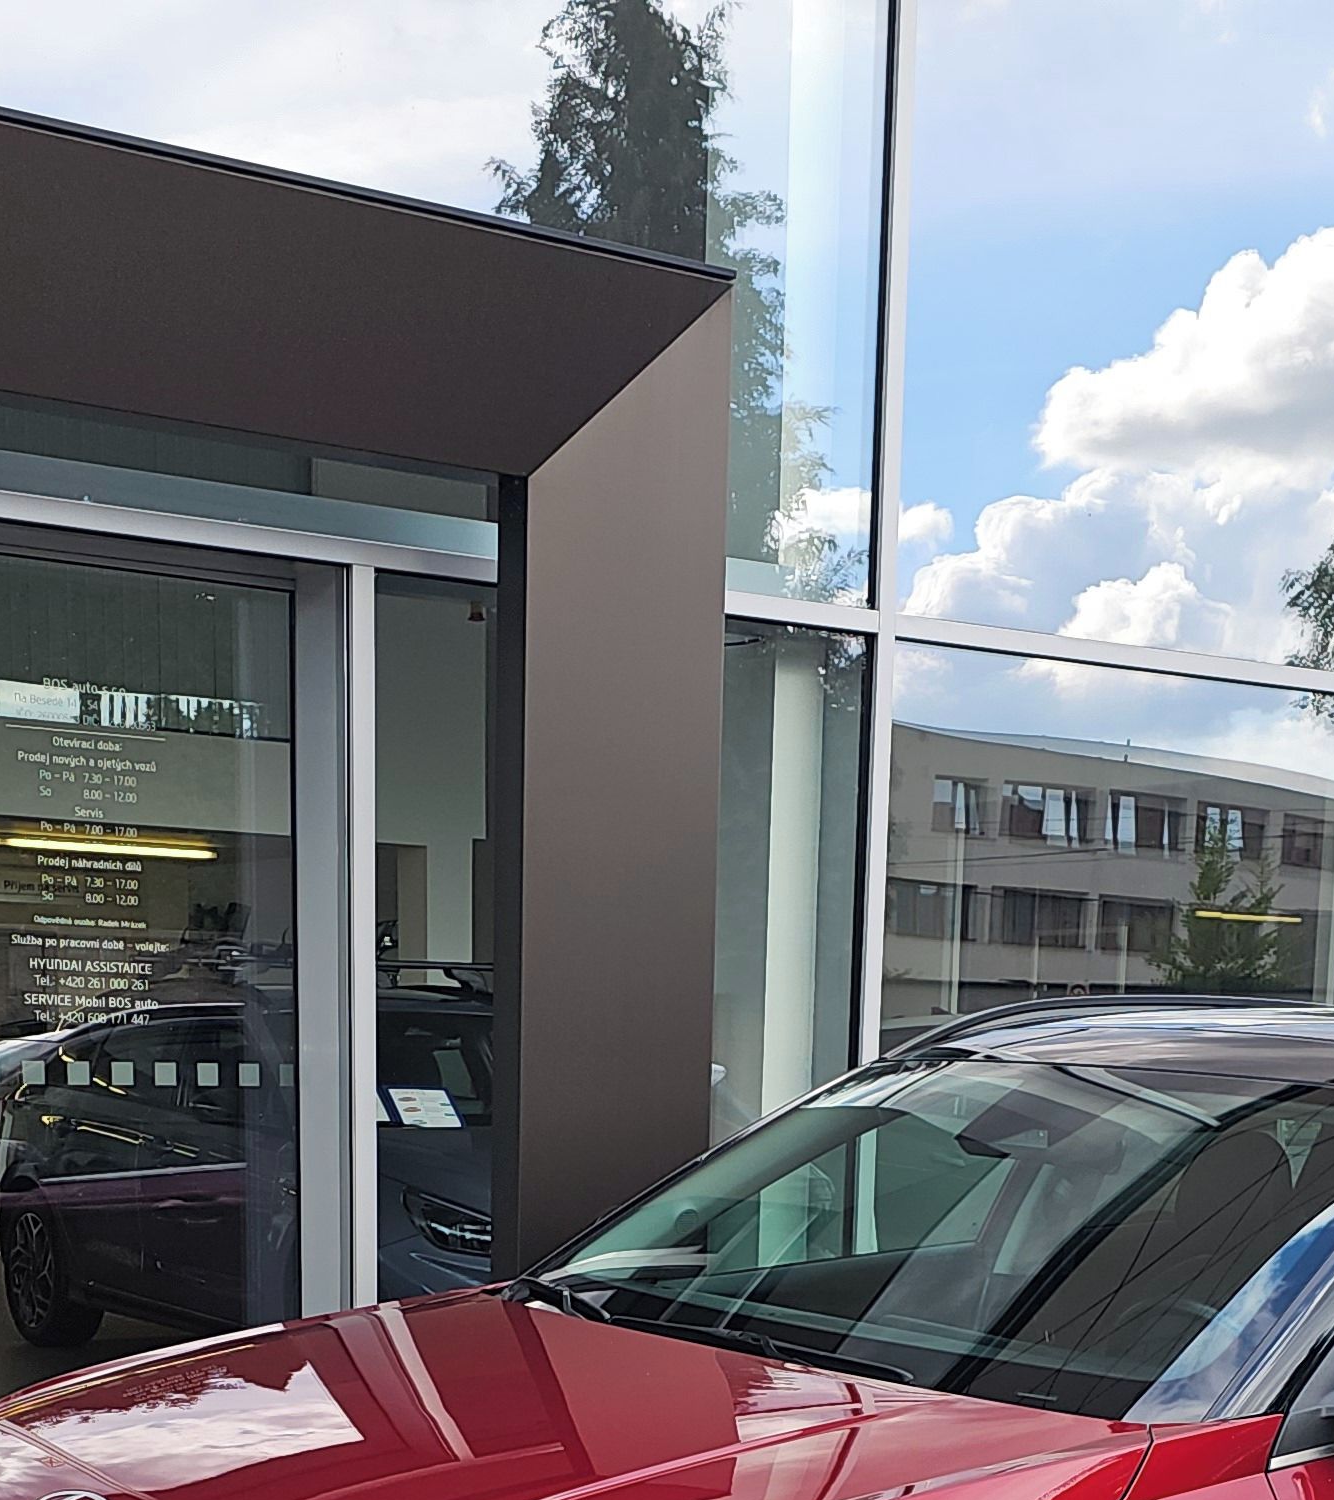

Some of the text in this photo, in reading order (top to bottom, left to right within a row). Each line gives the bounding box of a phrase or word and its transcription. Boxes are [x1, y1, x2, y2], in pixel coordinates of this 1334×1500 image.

[41, 677, 69, 691] BOS
[97, 740, 123, 751] doba:
[17, 750, 50, 765] Prodej
[52, 755, 87, 768] nových
[97, 758, 133, 772] ojetých
[134, 761, 157, 773] vozů
[39, 769, 52, 780] Po
[62, 771, 75, 783] Pá
[82, 773, 103, 785] 7.30
[113, 775, 137, 787] 17.00
[39, 785, 52, 797] So
[83, 789, 103, 801] 8.00
[114, 791, 137, 803] 12.00
[74, 806, 104, 818] Servis
[40, 821, 53, 832] Po
[63, 822, 76, 834] Pá
[84, 824, 104, 836] 7.00
[114, 826, 138, 838] 17.00
[37, 855, 69, 869] Prodej
[71, 858, 123, 871] náhradních
[41, 874, 54, 885] Po
[65, 875, 77, 886] Pá
[85, 876, 104, 888] 7.30
[115, 878, 138, 890] 17.00
[41, 890, 54, 901] So
[85, 893, 105, 904] 8.00
[115, 894, 139, 906] 12.00
[11, 933, 43, 945] Služba
[45, 937, 58, 948] po
[59, 938, 100, 949] pracovní
[102, 938, 125, 950] době
[134, 942, 170, 954] volejte:
[29, 957, 153, 975] HYUNDAI ASSISTANCE
[33, 974, 149, 991] Tel.: +420 261 000 261
[23, 993, 159, 1010] SERVICE Mobil BOS auto
[33, 1010, 56, 1022] Tel.:
[58, 1012, 85, 1023] +420
[130, 1014, 150, 1025] 447
